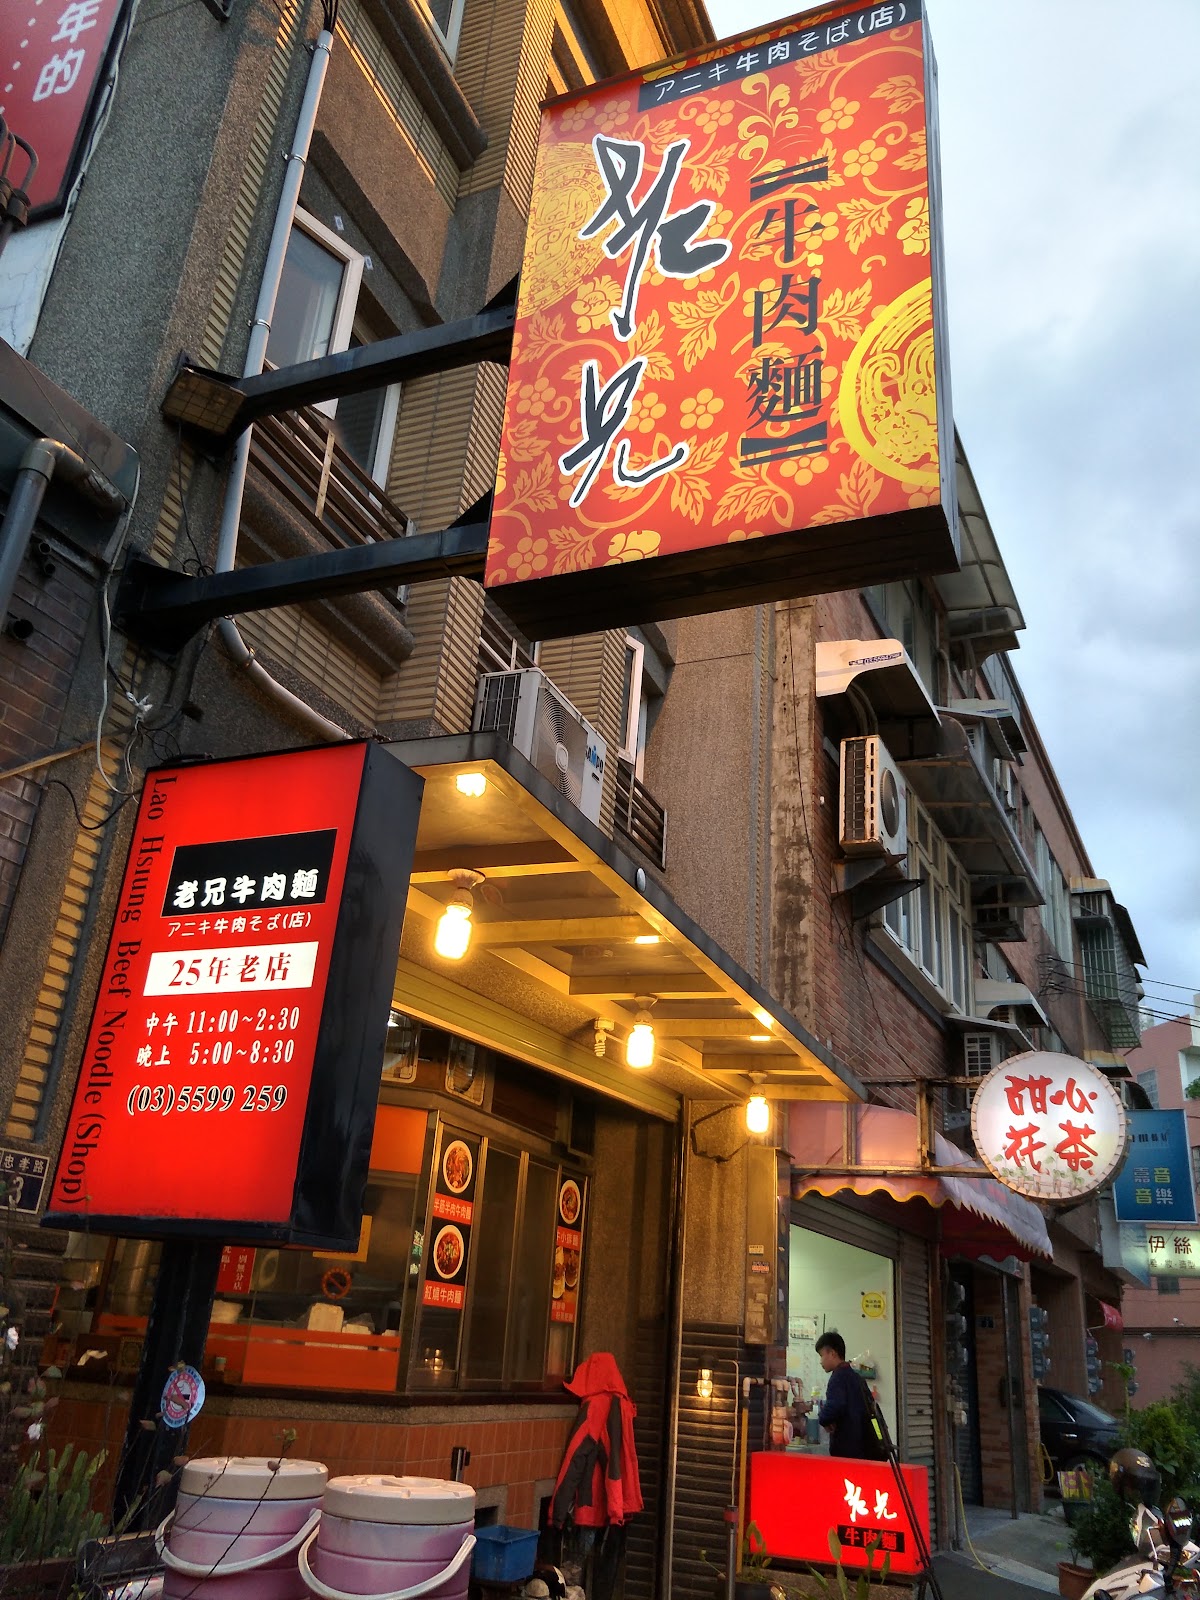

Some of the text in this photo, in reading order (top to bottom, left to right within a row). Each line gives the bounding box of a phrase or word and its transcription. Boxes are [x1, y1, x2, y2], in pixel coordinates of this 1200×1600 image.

[655, 3, 907, 102] アニキ牛肉そば(店)
[172, 868, 319, 909] 老兄牛肉麵
[167, 911, 312, 938] アニキ牛肉そば(店)
[168, 952, 292, 987] 25年老店
[58, 776, 178, 1204] Lao Hsiung Beef Noodle (Shop)
[146, 1006, 300, 1036] 中午 11:00~2:30
[136, 1039, 295, 1067] 晚上 5:00~8:30
[127, 1084, 288, 1116] (03)5599 259
[1004, 1074, 1098, 1116] 甜心
[4, 1154, 44, 1173] 忠孝路
